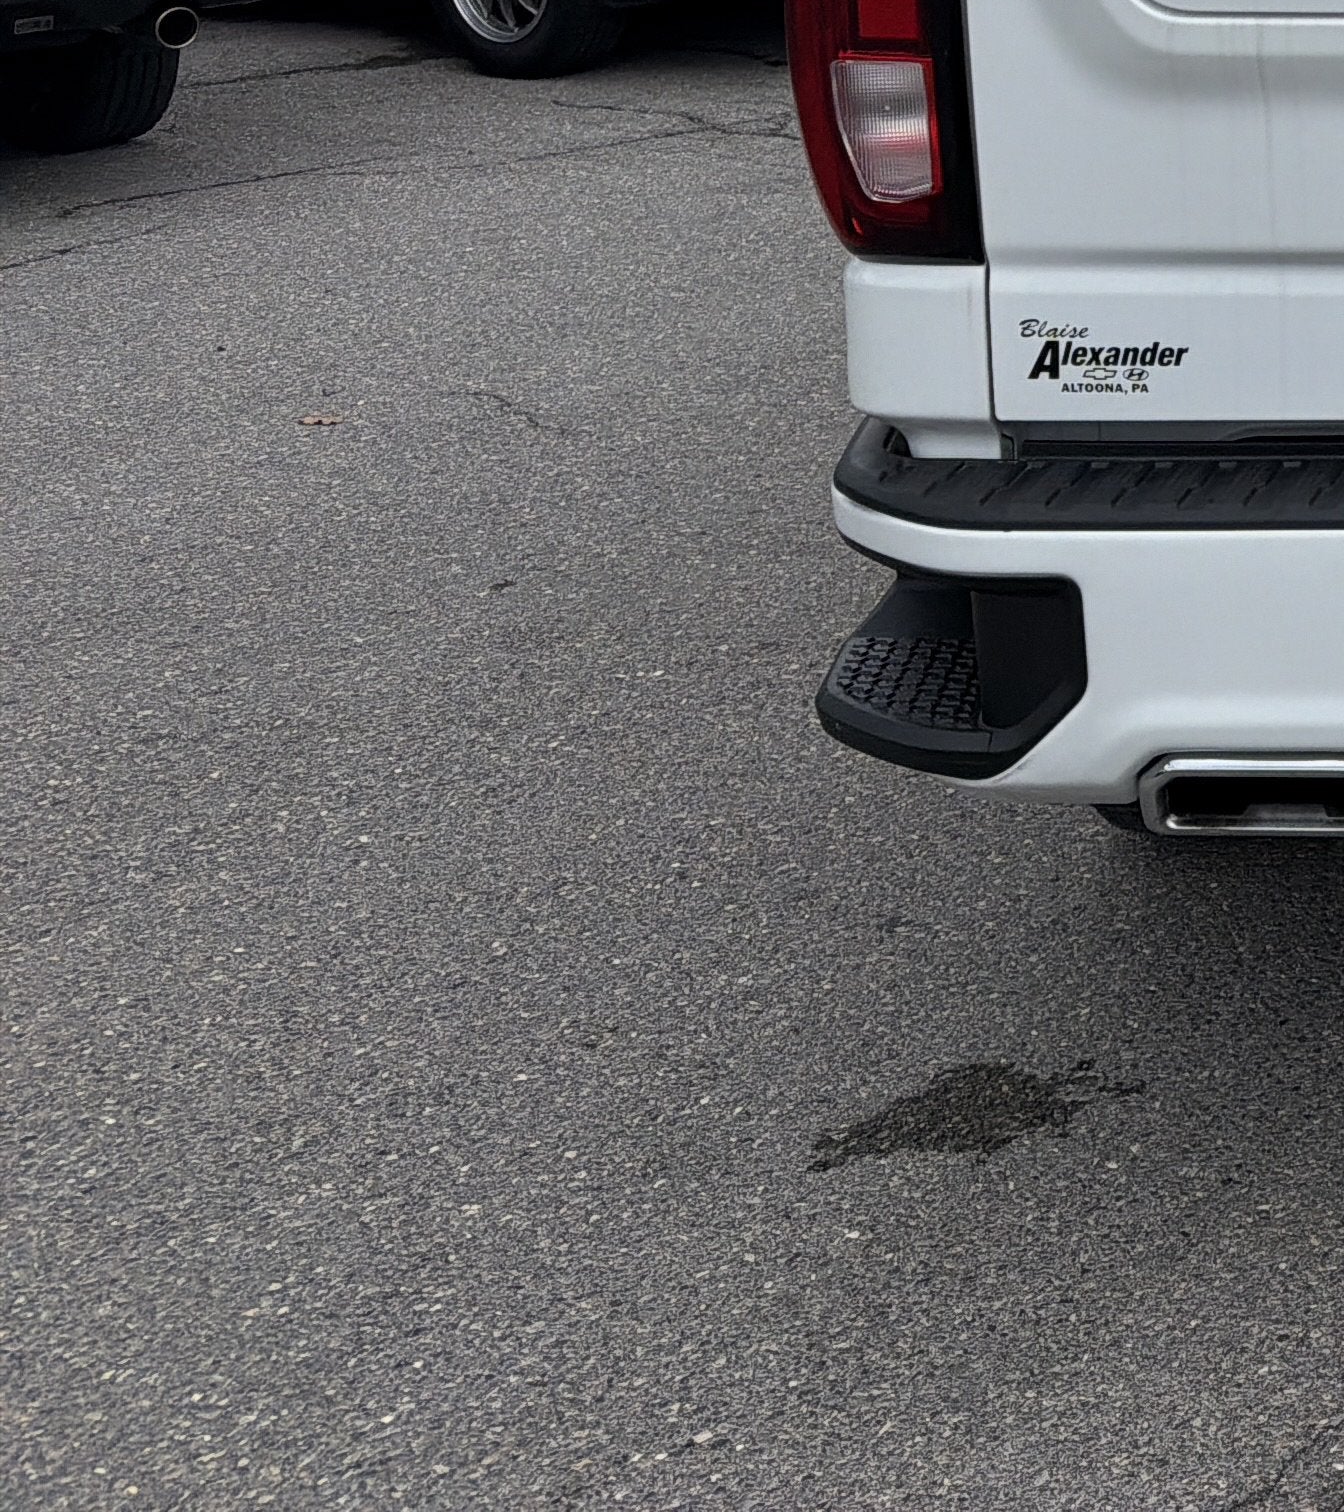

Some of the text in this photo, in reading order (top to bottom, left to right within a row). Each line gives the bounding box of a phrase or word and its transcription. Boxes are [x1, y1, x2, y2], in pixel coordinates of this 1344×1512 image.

[1018, 318, 1089, 338] Blaise
[1027, 340, 1189, 379] Alexander
[1061, 383, 1149, 395] ALTOONA, PA
